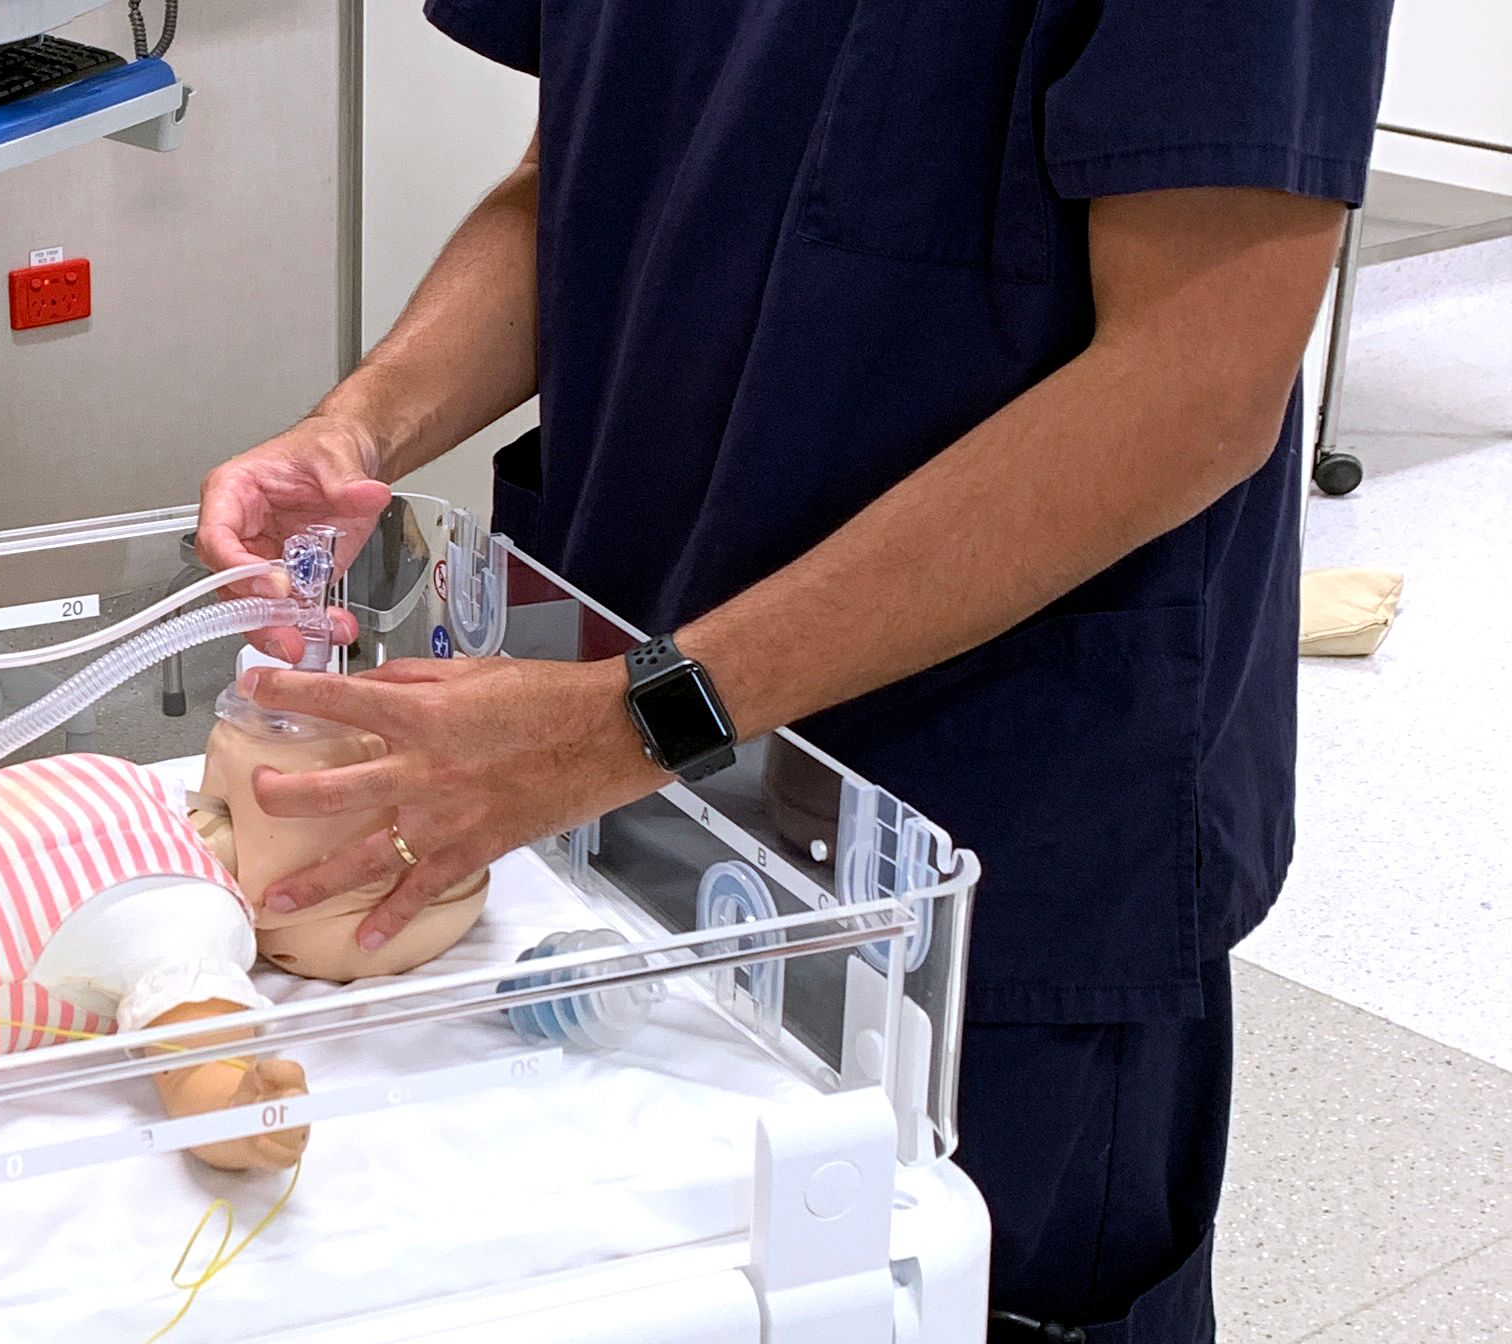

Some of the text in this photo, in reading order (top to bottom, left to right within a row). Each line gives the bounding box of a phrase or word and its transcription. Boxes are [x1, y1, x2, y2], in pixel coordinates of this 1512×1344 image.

[61, 600, 84, 617] 20
[701, 807, 710, 826] A
[757, 847, 767, 867] B
